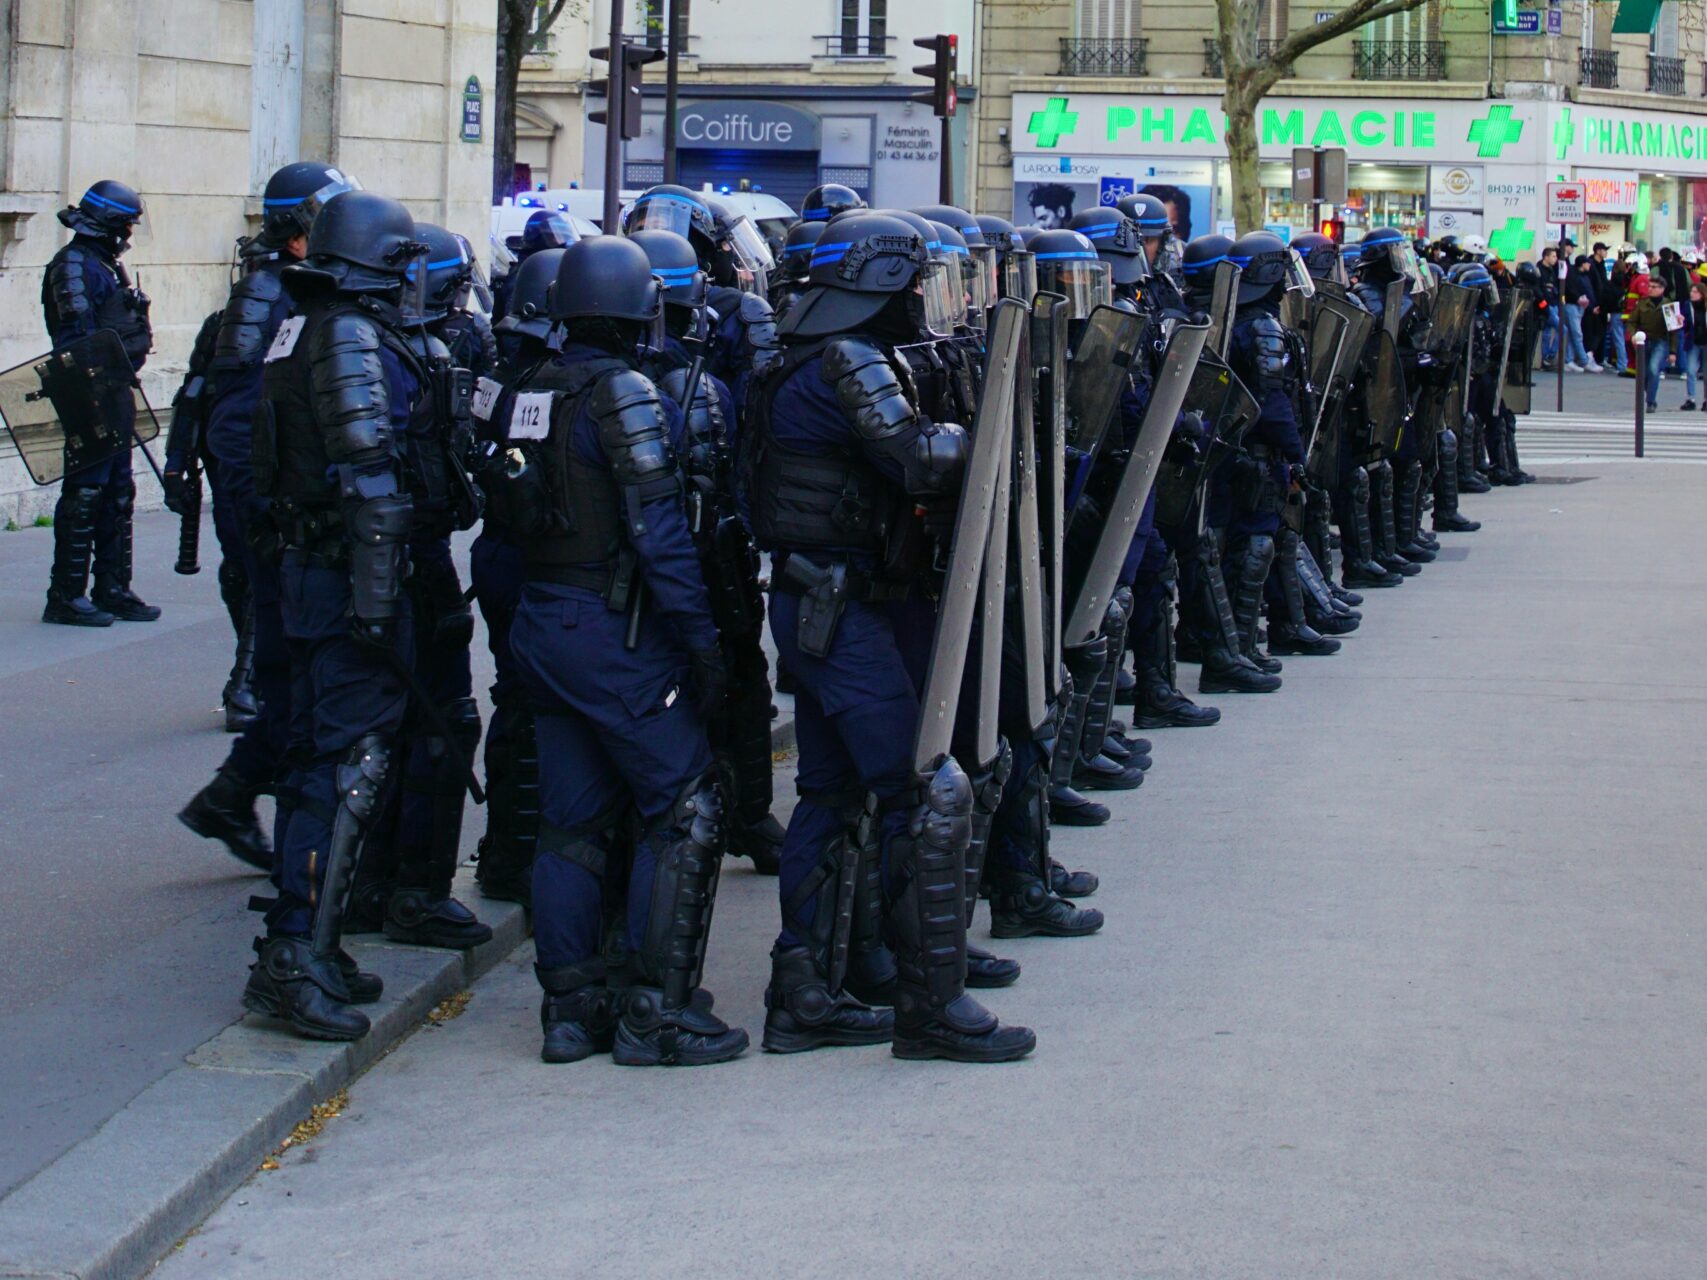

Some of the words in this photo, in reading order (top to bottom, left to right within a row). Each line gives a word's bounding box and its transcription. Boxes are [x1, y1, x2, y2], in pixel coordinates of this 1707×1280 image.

[681, 113, 793, 142] Coiffure
[887, 126, 930, 138] Féminin
[1106, 106, 1437, 148] PHAMACIE
[883, 139, 933, 150] Masculin
[1583, 116, 1707, 161] PHARMACI
[877, 150, 887, 160] 01
[903, 151, 913, 160] 44
[1515, 185, 1536, 194] 21H
[1503, 197, 1520, 206] 7/7
[521, 405, 540, 426] 112
